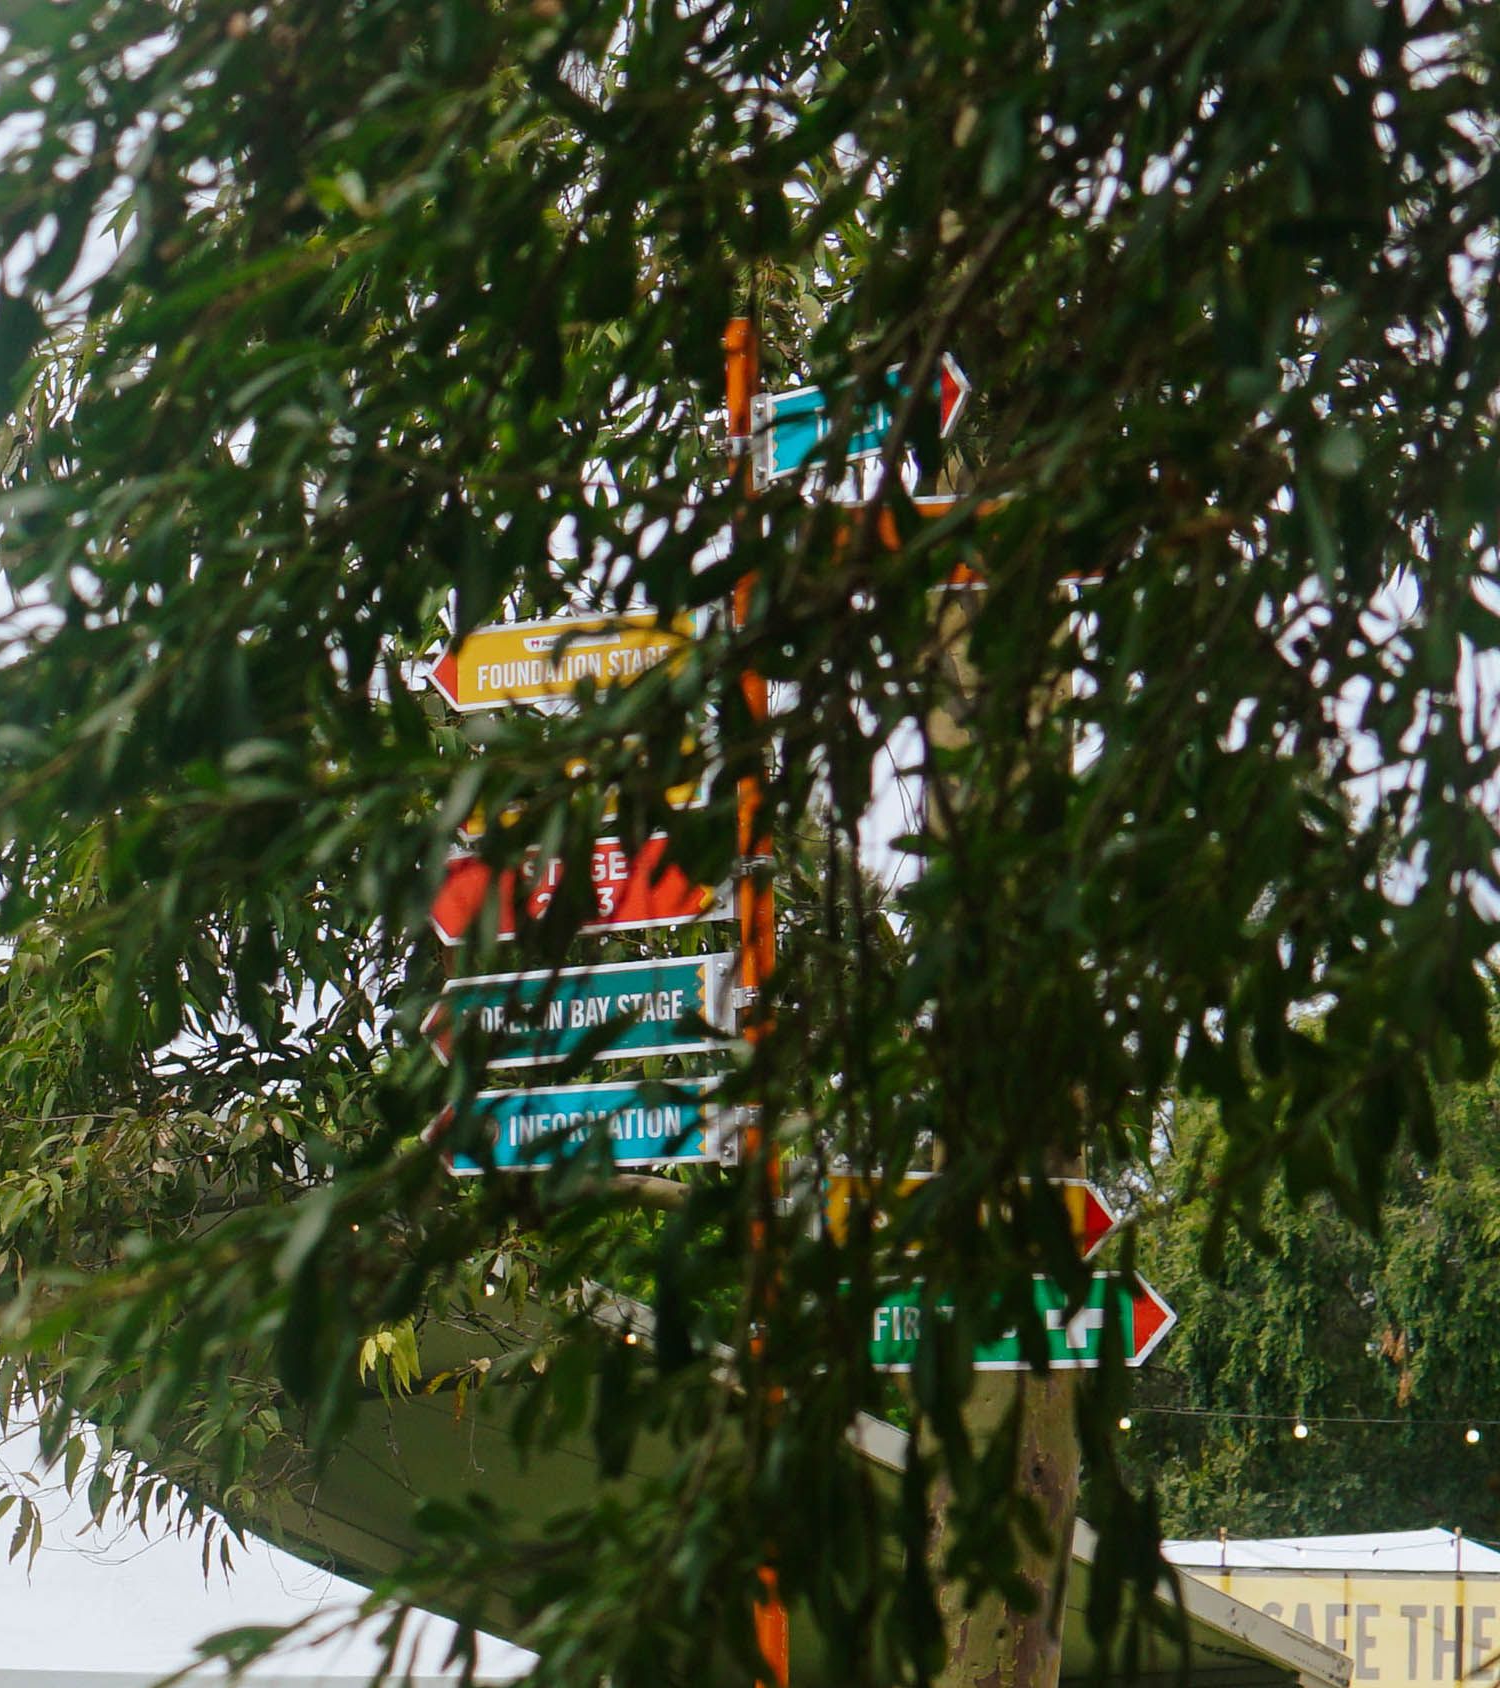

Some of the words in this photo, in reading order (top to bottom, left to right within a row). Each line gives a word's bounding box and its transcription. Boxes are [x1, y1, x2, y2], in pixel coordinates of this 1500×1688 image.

[477, 652, 602, 691] FOUNDATION
[523, 851, 628, 887] TGE
[597, 888, 614, 917] 3
[571, 996, 611, 1028] BAY
[618, 990, 684, 1024] STAGE
